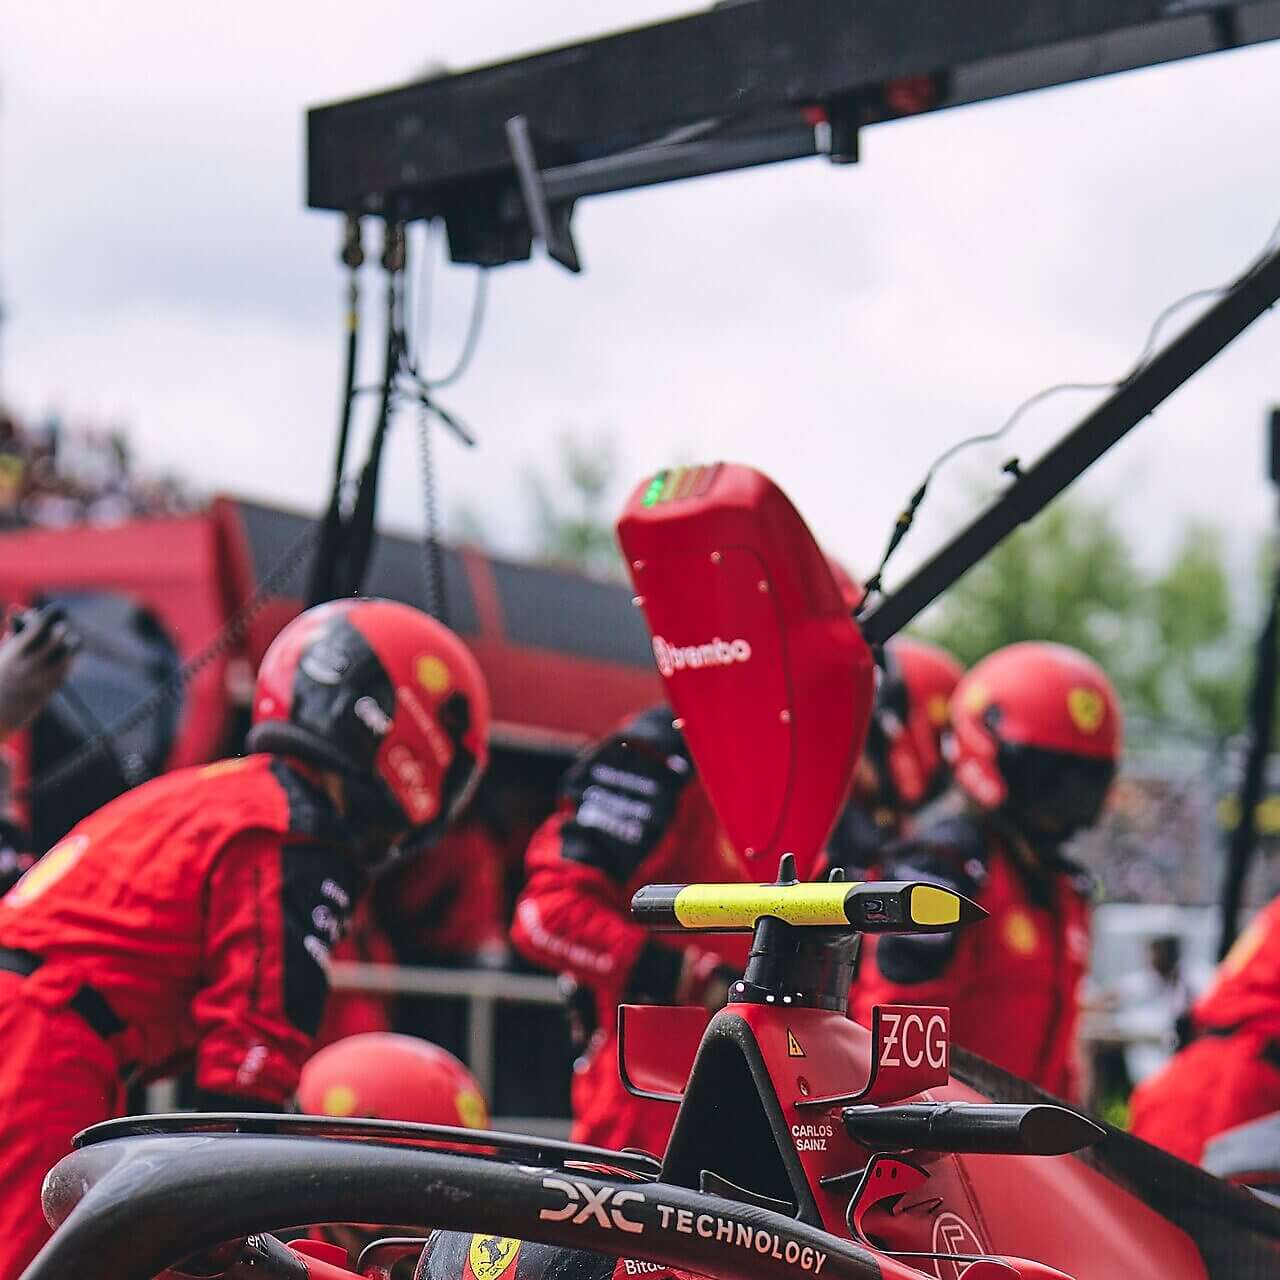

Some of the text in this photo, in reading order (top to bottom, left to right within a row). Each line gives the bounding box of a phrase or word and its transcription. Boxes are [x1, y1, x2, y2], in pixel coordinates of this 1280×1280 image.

[880, 1014, 947, 1070] ZCG
[792, 1125, 834, 1138] CARLOS
[796, 1139, 827, 1151] SAINZ
[538, 1177, 827, 1275] DXC TECHNOLOGY
